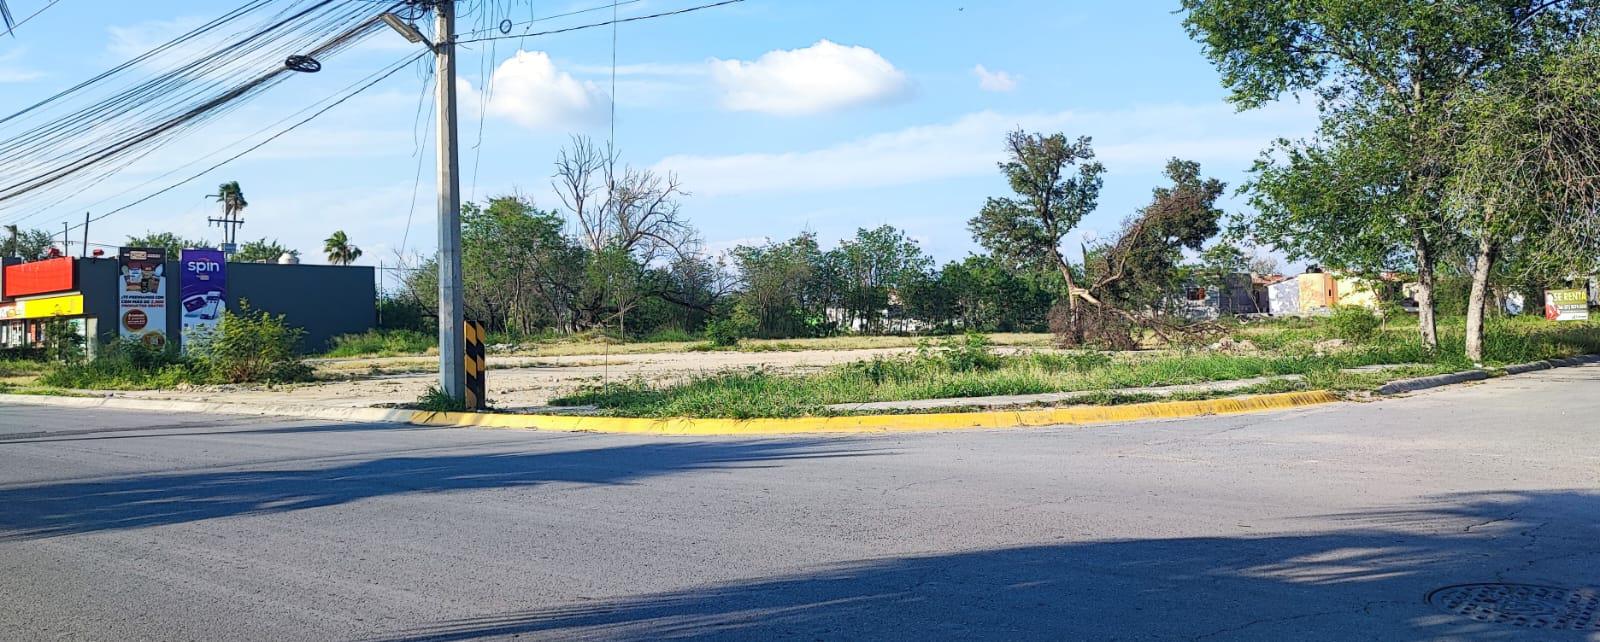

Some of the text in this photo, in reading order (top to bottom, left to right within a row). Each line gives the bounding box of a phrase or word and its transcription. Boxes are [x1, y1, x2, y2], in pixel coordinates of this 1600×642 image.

[187, 261, 220, 274] spin
[1553, 291, 1587, 301] SE RENTA
